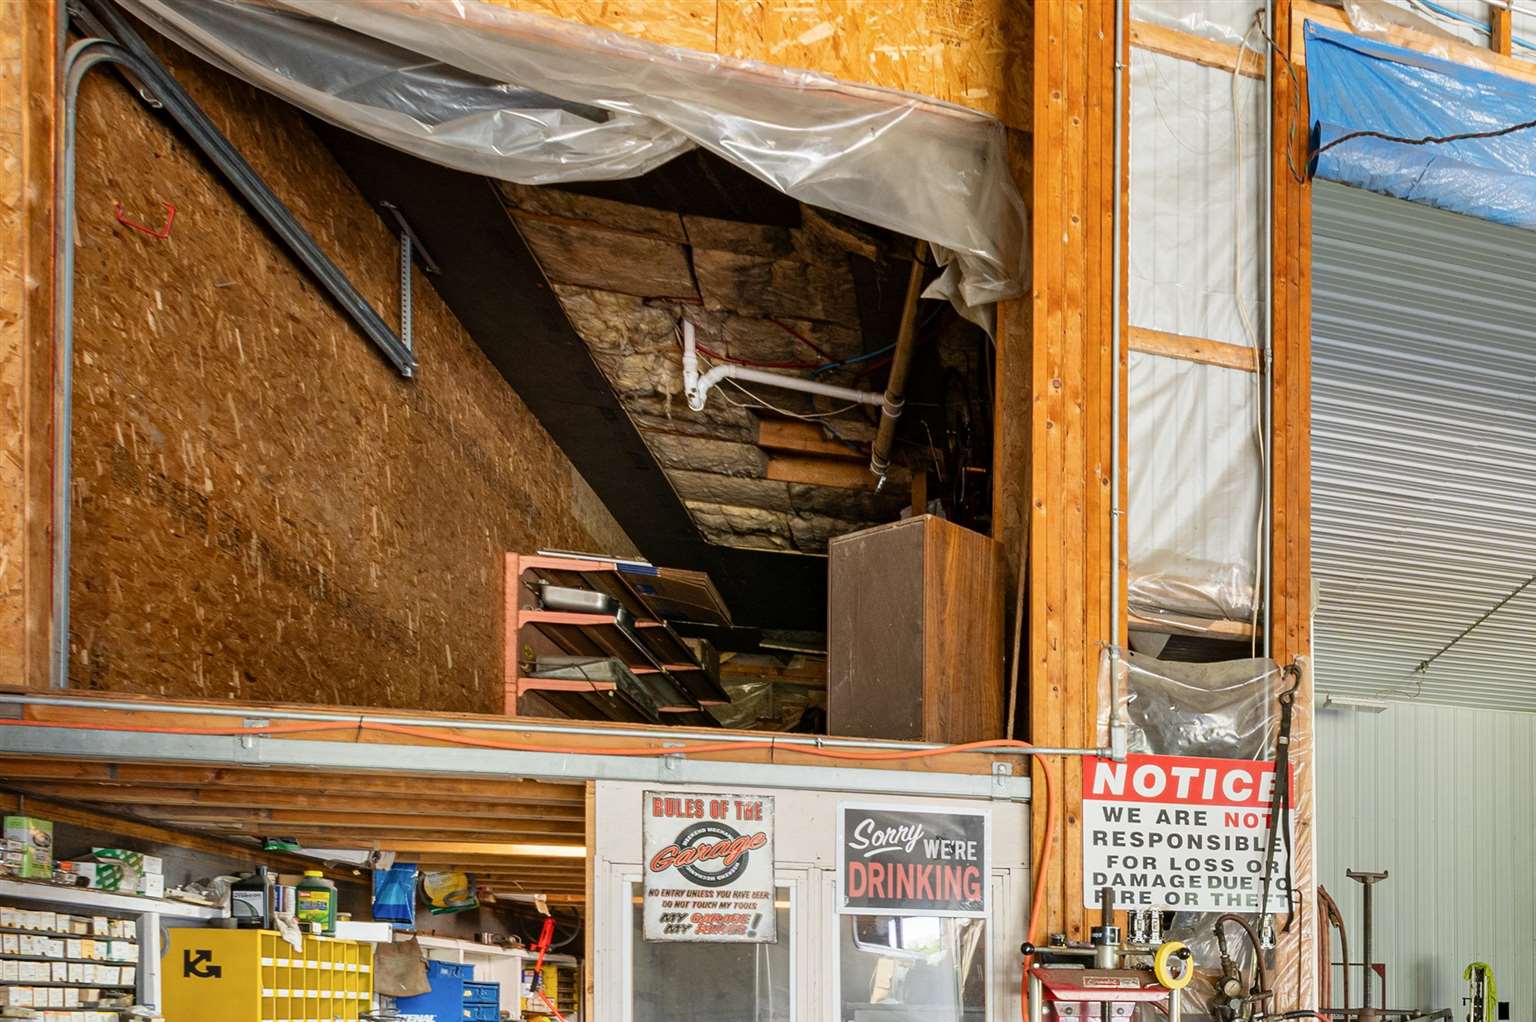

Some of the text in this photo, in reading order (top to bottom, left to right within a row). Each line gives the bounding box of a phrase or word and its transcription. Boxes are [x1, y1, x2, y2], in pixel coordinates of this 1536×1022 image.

[1092, 762, 1277, 803] NOTICE
[652, 797, 763, 821] RULES OF THE
[1103, 806, 1273, 830] WE ARE NOT
[848, 818, 925, 853] Sorry
[1093, 830, 1283, 853] RESPONSIBLE
[649, 831, 768, 873] Garage
[923, 839, 977, 861] WE'RE
[1107, 855, 1279, 874] FOR LOSS OR
[848, 861, 982, 901] DRINKING
[1093, 872, 1202, 889] DAMAGE
[1207, 876, 1253, 891] DUE
[648, 888, 660, 897] NO
[661, 889, 686, 898] ENTRY
[686, 889, 715, 898] UNLESS
[716, 890, 732, 898] YOU
[733, 890, 751, 899] HAVE
[662, 900, 673, 908] DO
[674, 900, 690, 909] NOT
[692, 901, 718, 909] TOUCH
[719, 901, 733, 909] MY
[1164, 892, 1199, 907] OR
[659, 912, 689, 923] MY
[663, 924, 692, 934] MY
